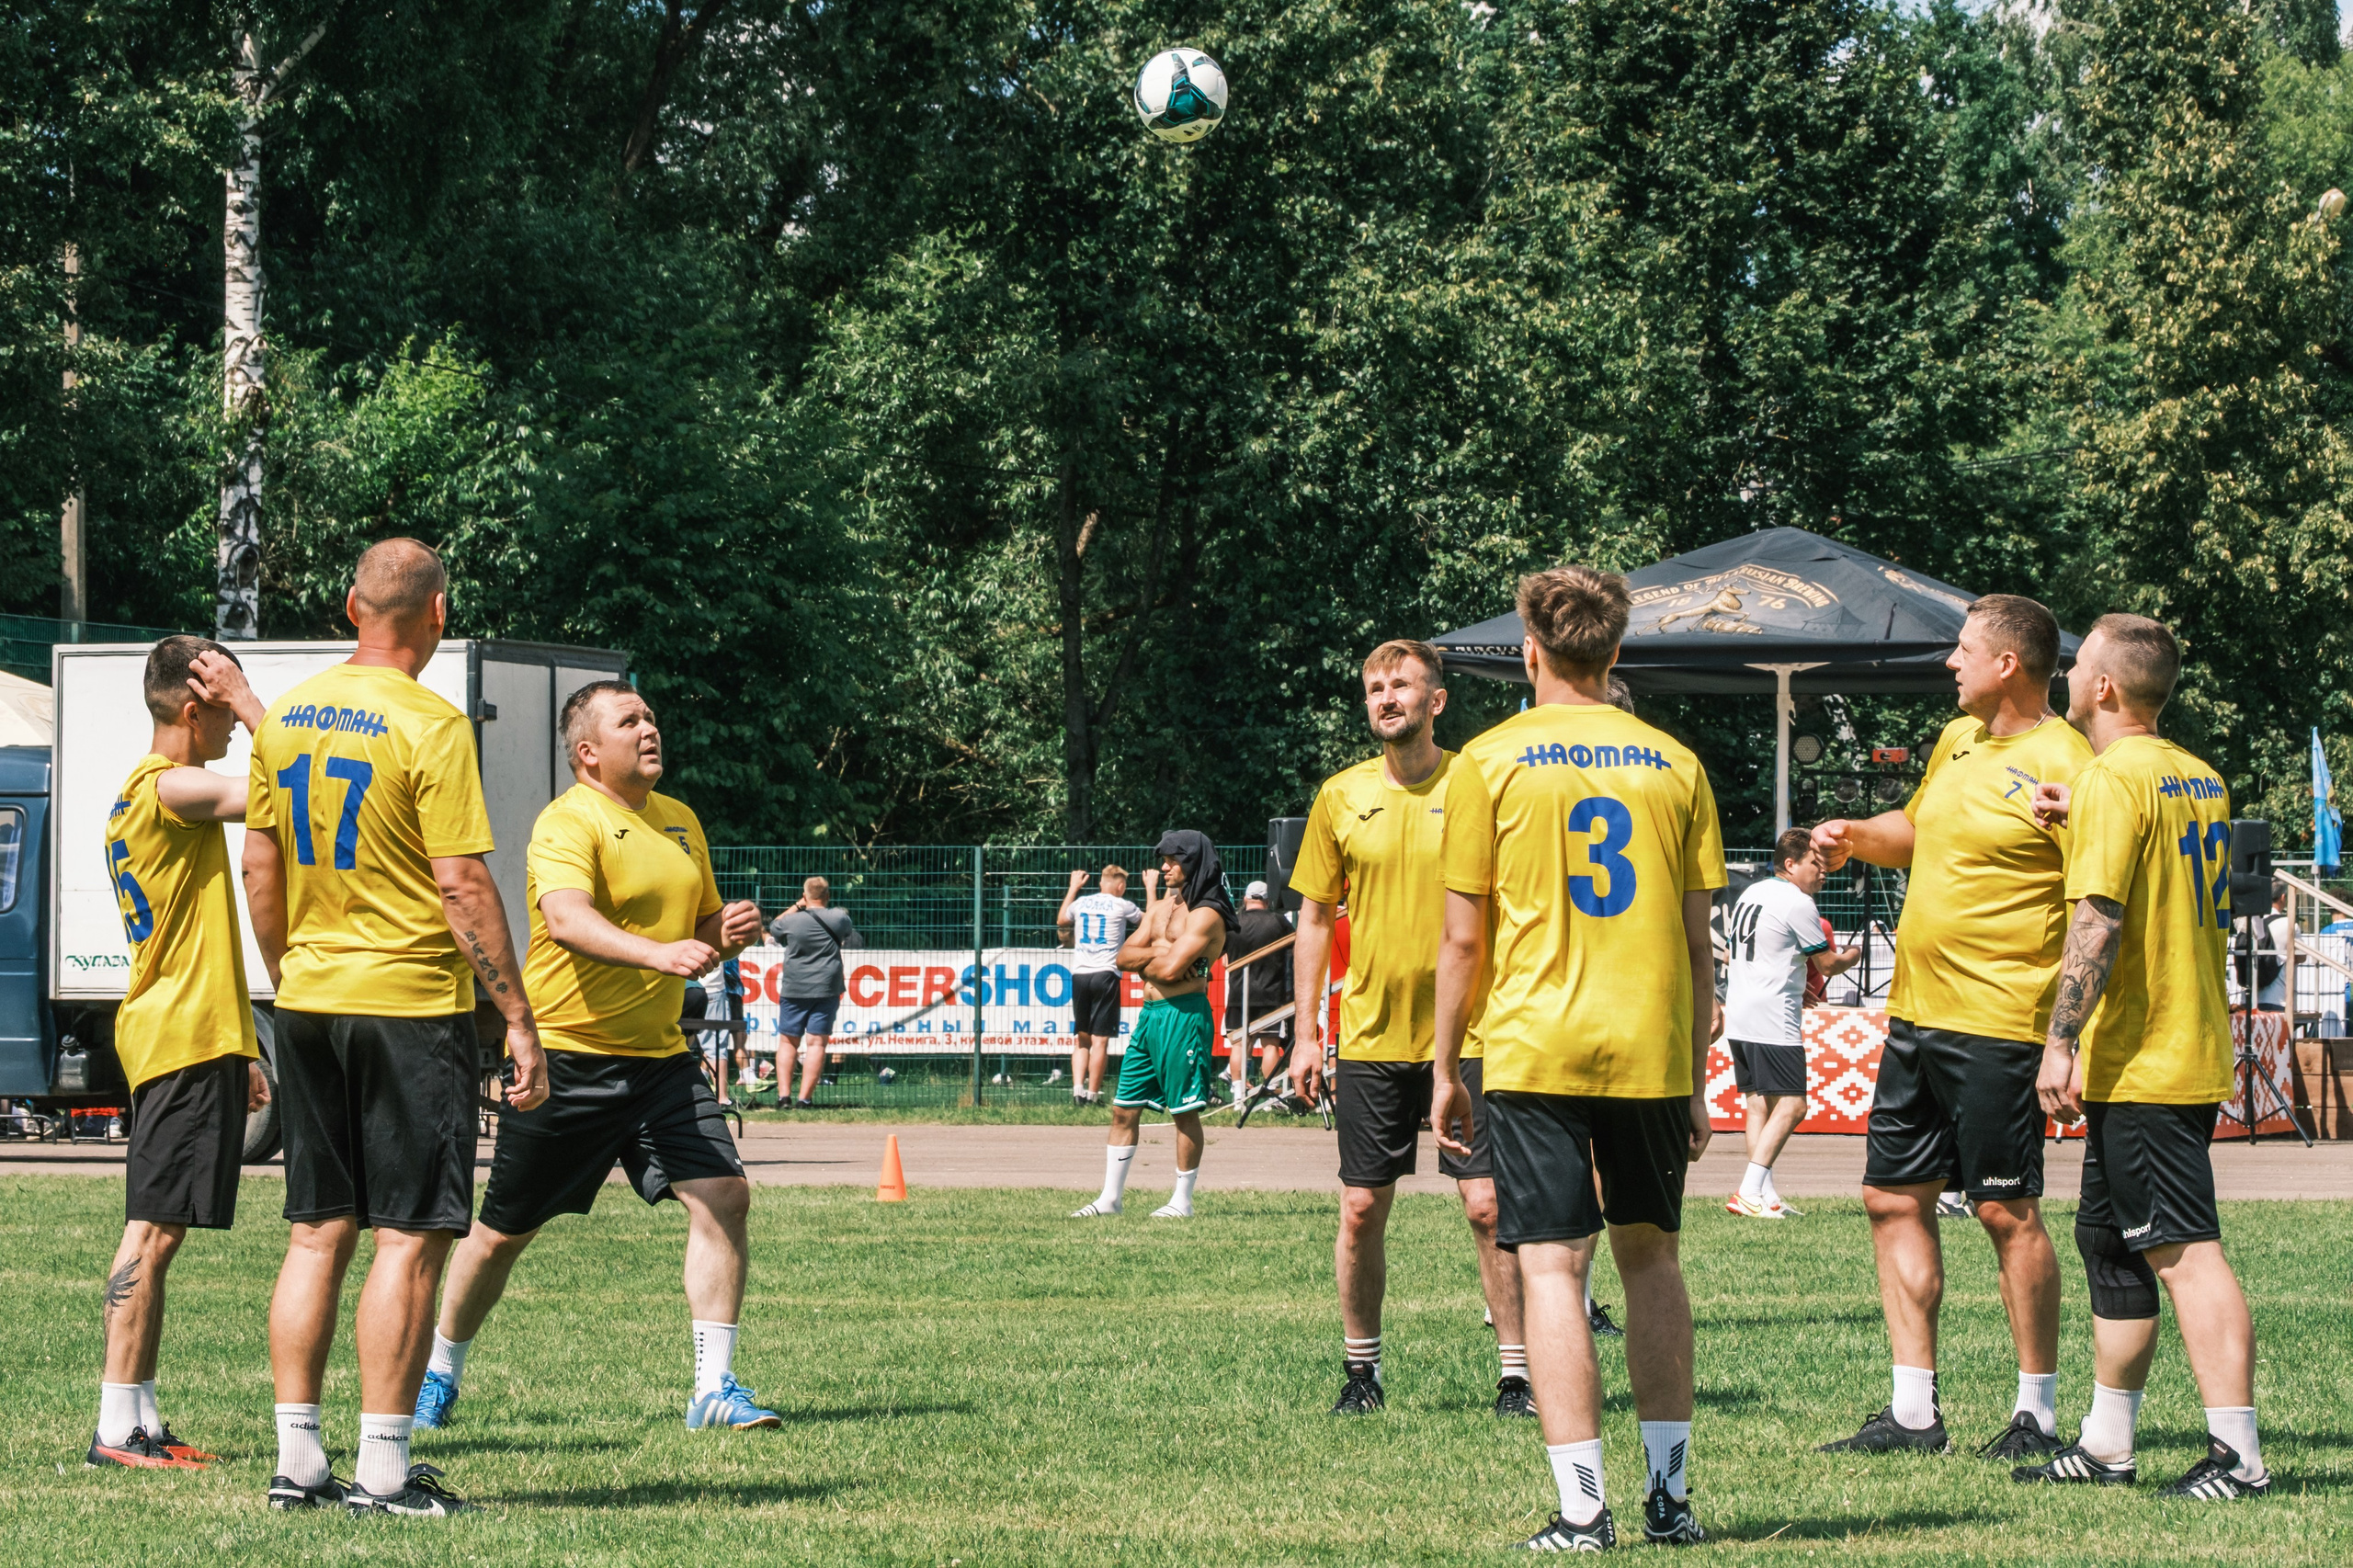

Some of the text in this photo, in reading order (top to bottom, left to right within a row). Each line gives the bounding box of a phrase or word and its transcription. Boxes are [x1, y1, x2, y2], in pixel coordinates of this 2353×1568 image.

[1667, 596, 1788, 610] 18 76
[1783, 578, 1831, 608] BREWING
[2004, 780, 2022, 799] 7
[277, 754, 373, 870] 17
[677, 835, 691, 855] 5
[1568, 796, 1637, 917] 3
[2178, 821, 2232, 929] 12
[1079, 912, 1108, 945] 11
[961, 1034, 1013, 1048] нуевой
[1983, 1176, 2021, 1188] uhlsport
[368, 1433, 409, 1441] adidas
[1656, 1495, 1665, 1519] COPA
[1606, 1516, 1615, 1543] COPA
